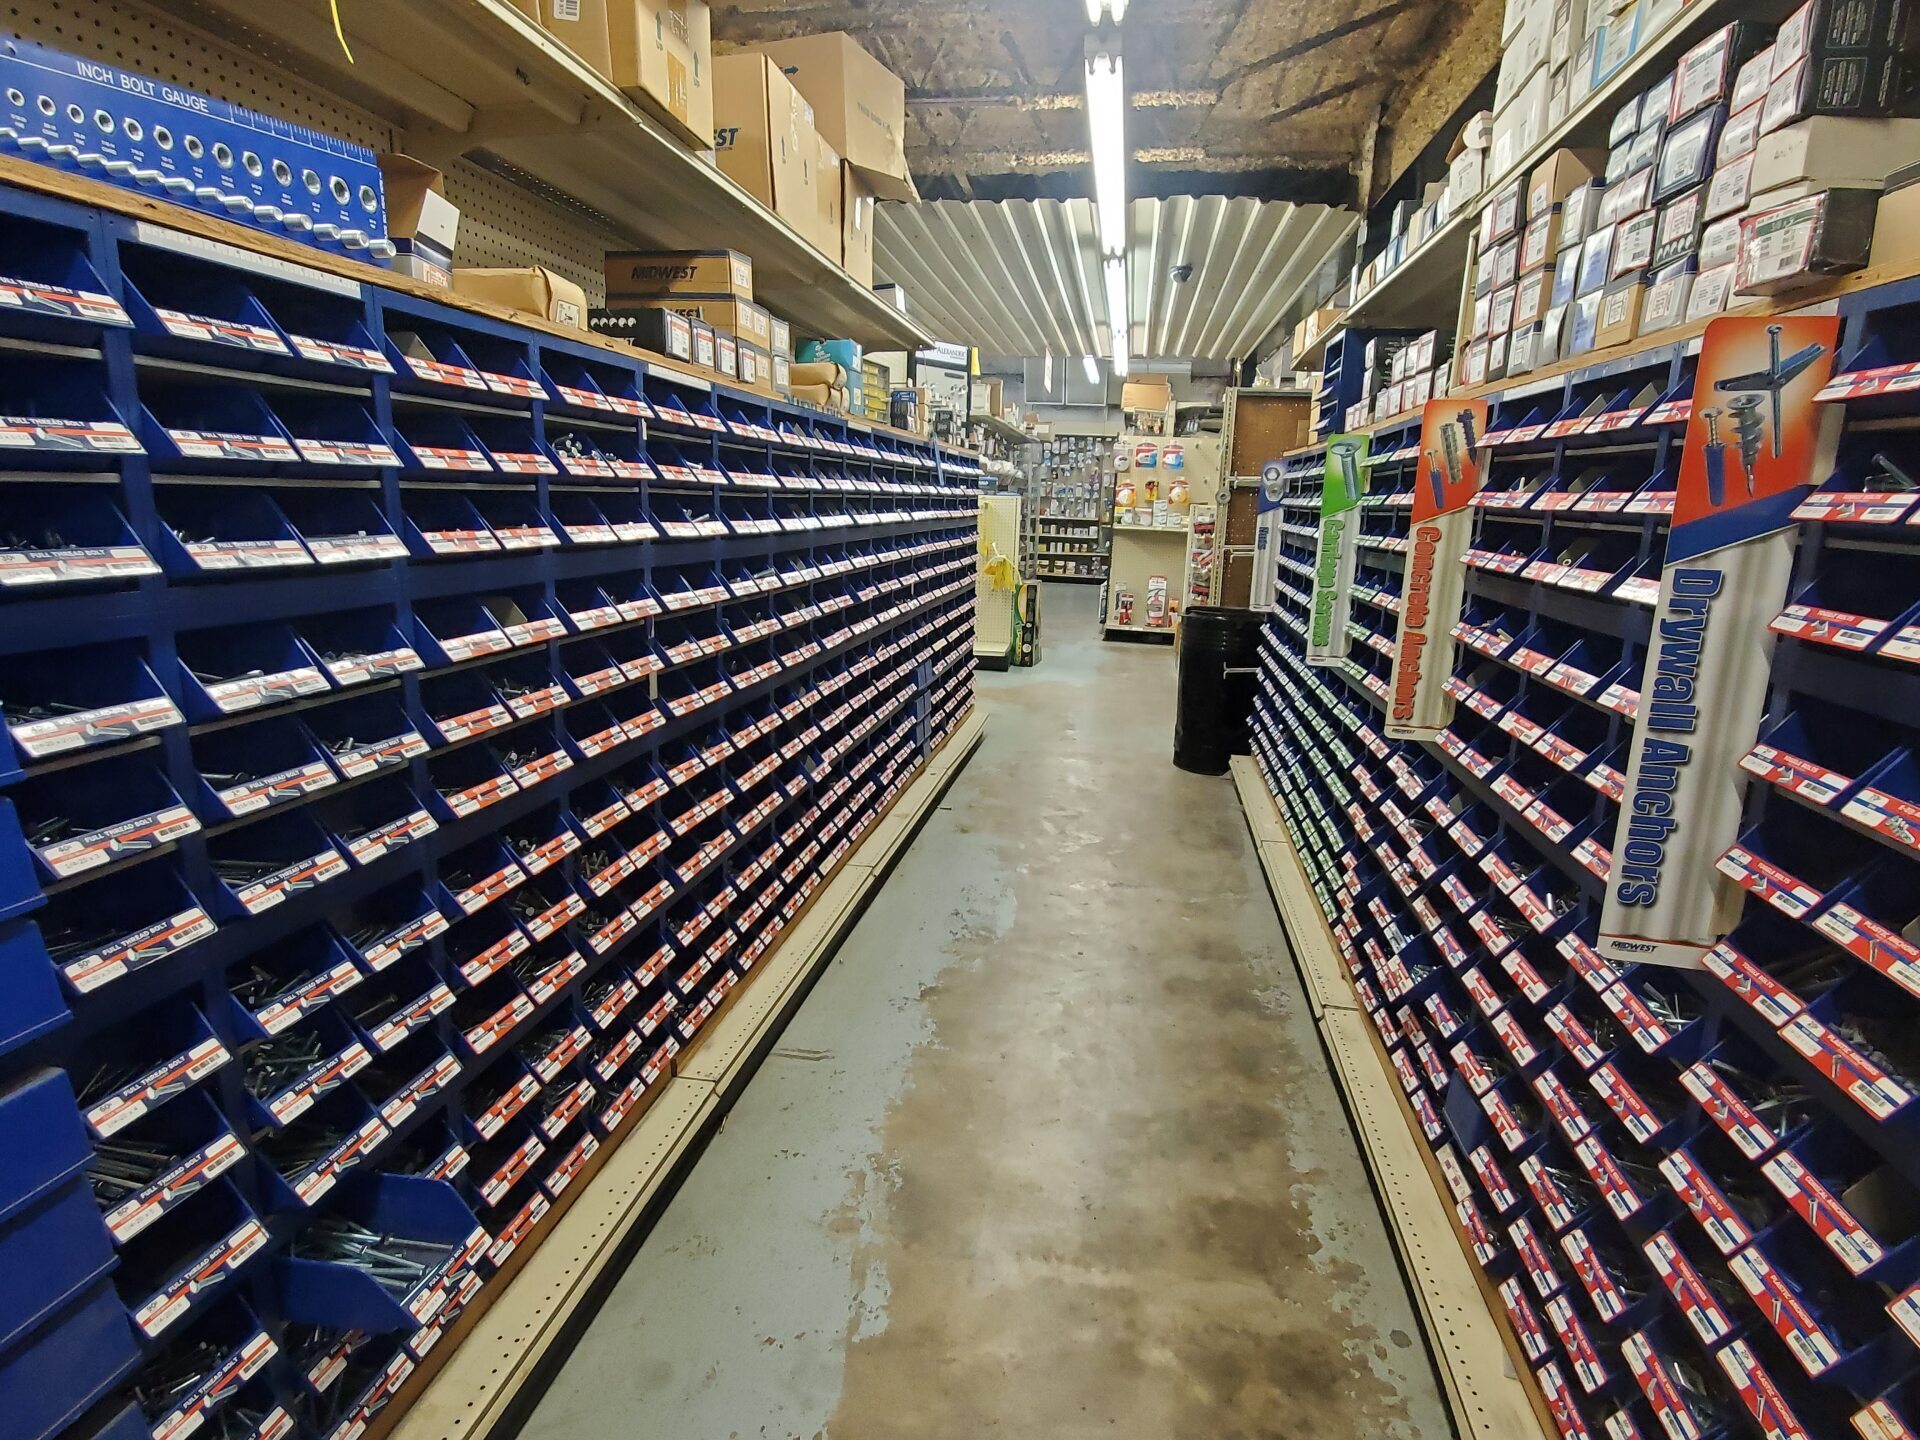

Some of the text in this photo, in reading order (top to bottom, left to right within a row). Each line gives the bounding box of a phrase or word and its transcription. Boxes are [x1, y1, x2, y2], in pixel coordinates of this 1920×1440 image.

[76, 61, 210, 113] INCH BOLT GAUGE
[631, 265, 698, 280] MIDWEST
[1312, 590, 1338, 646] Screws
[1392, 526, 1441, 721] Concrete Anchors
[1616, 568, 1723, 907] Drywall Anchors
[248, 769, 301, 789] FULL THREAD BOLT
[83, 817, 154, 843] FULL THREAD BOLT
[264, 860, 313, 885] FULL THREAD BOLT
[101, 921, 169, 956] FULL THREAD BOLT
[1610, 940, 1659, 953] MIDWEST
[122, 1055, 186, 1097] FULL THREAD BOLT
[293, 1057, 339, 1091] FULL THREAD BOLT
[139, 1153, 202, 1199] FULL THREAD BOLT
[167, 1245, 226, 1293] FULL THREAD BOLT
[183, 1357, 238, 1408] FULL THREAD BOLT
